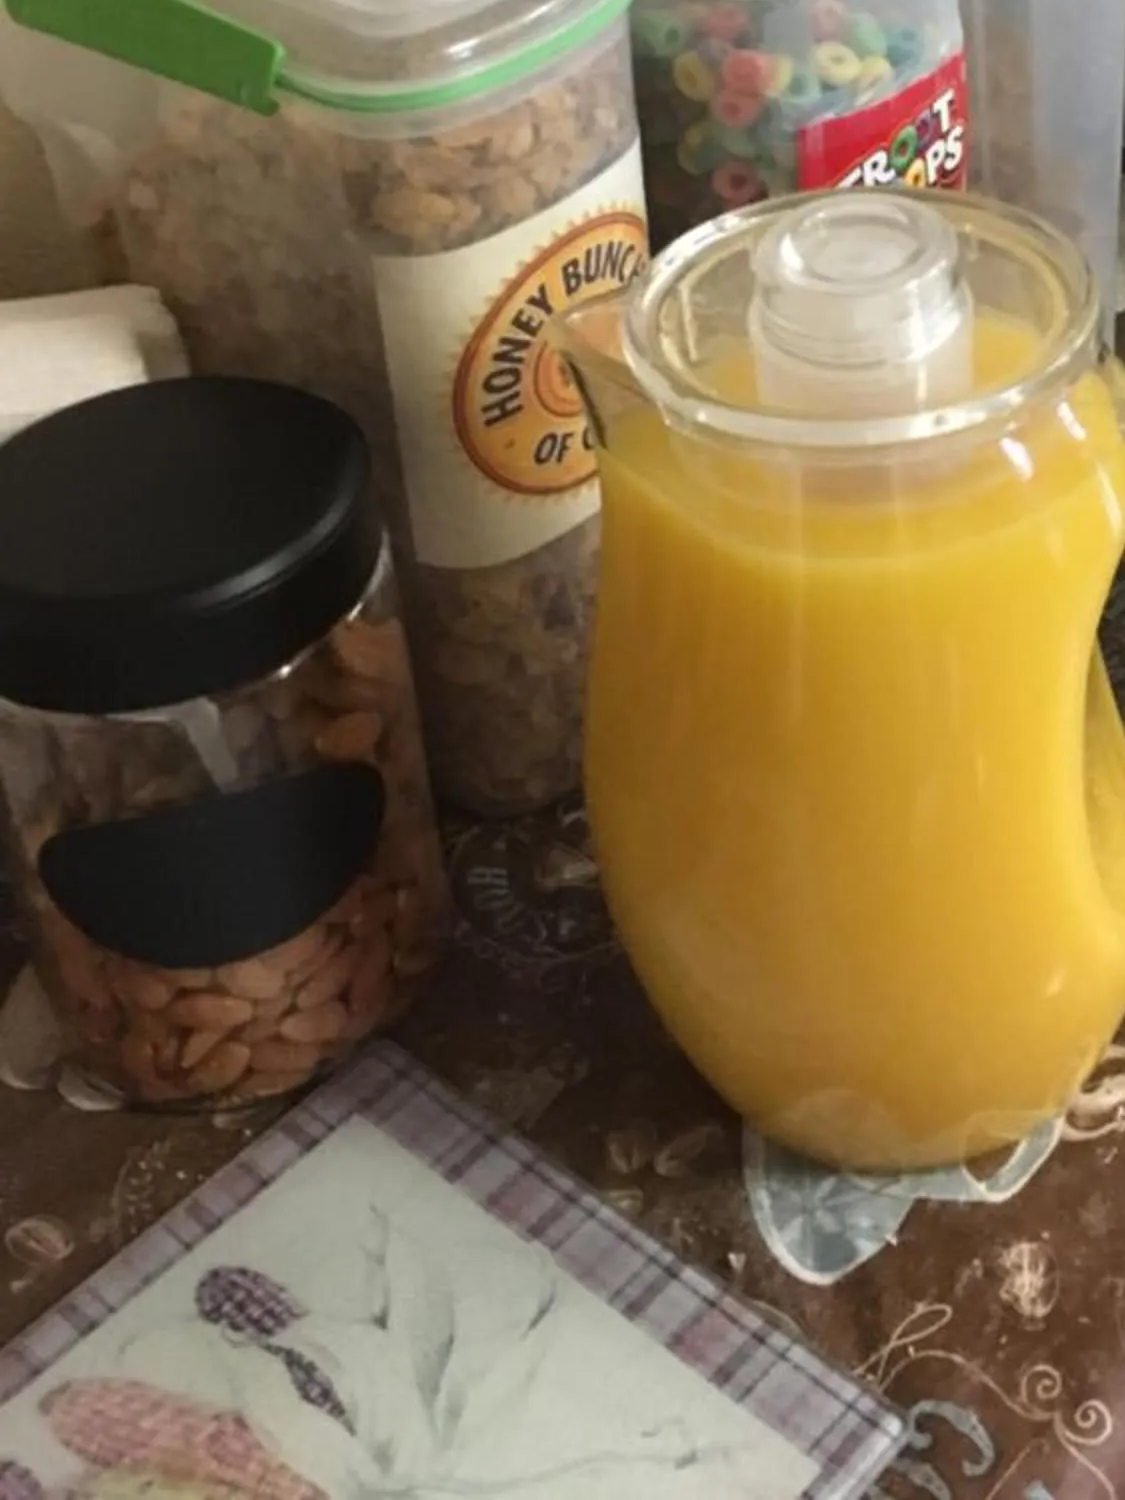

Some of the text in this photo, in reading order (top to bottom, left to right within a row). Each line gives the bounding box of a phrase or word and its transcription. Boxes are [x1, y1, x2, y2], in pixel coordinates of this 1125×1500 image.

[903, 125, 964, 188] OPS
[481, 284, 554, 427] HONEY
[533, 431, 574, 466] OF
